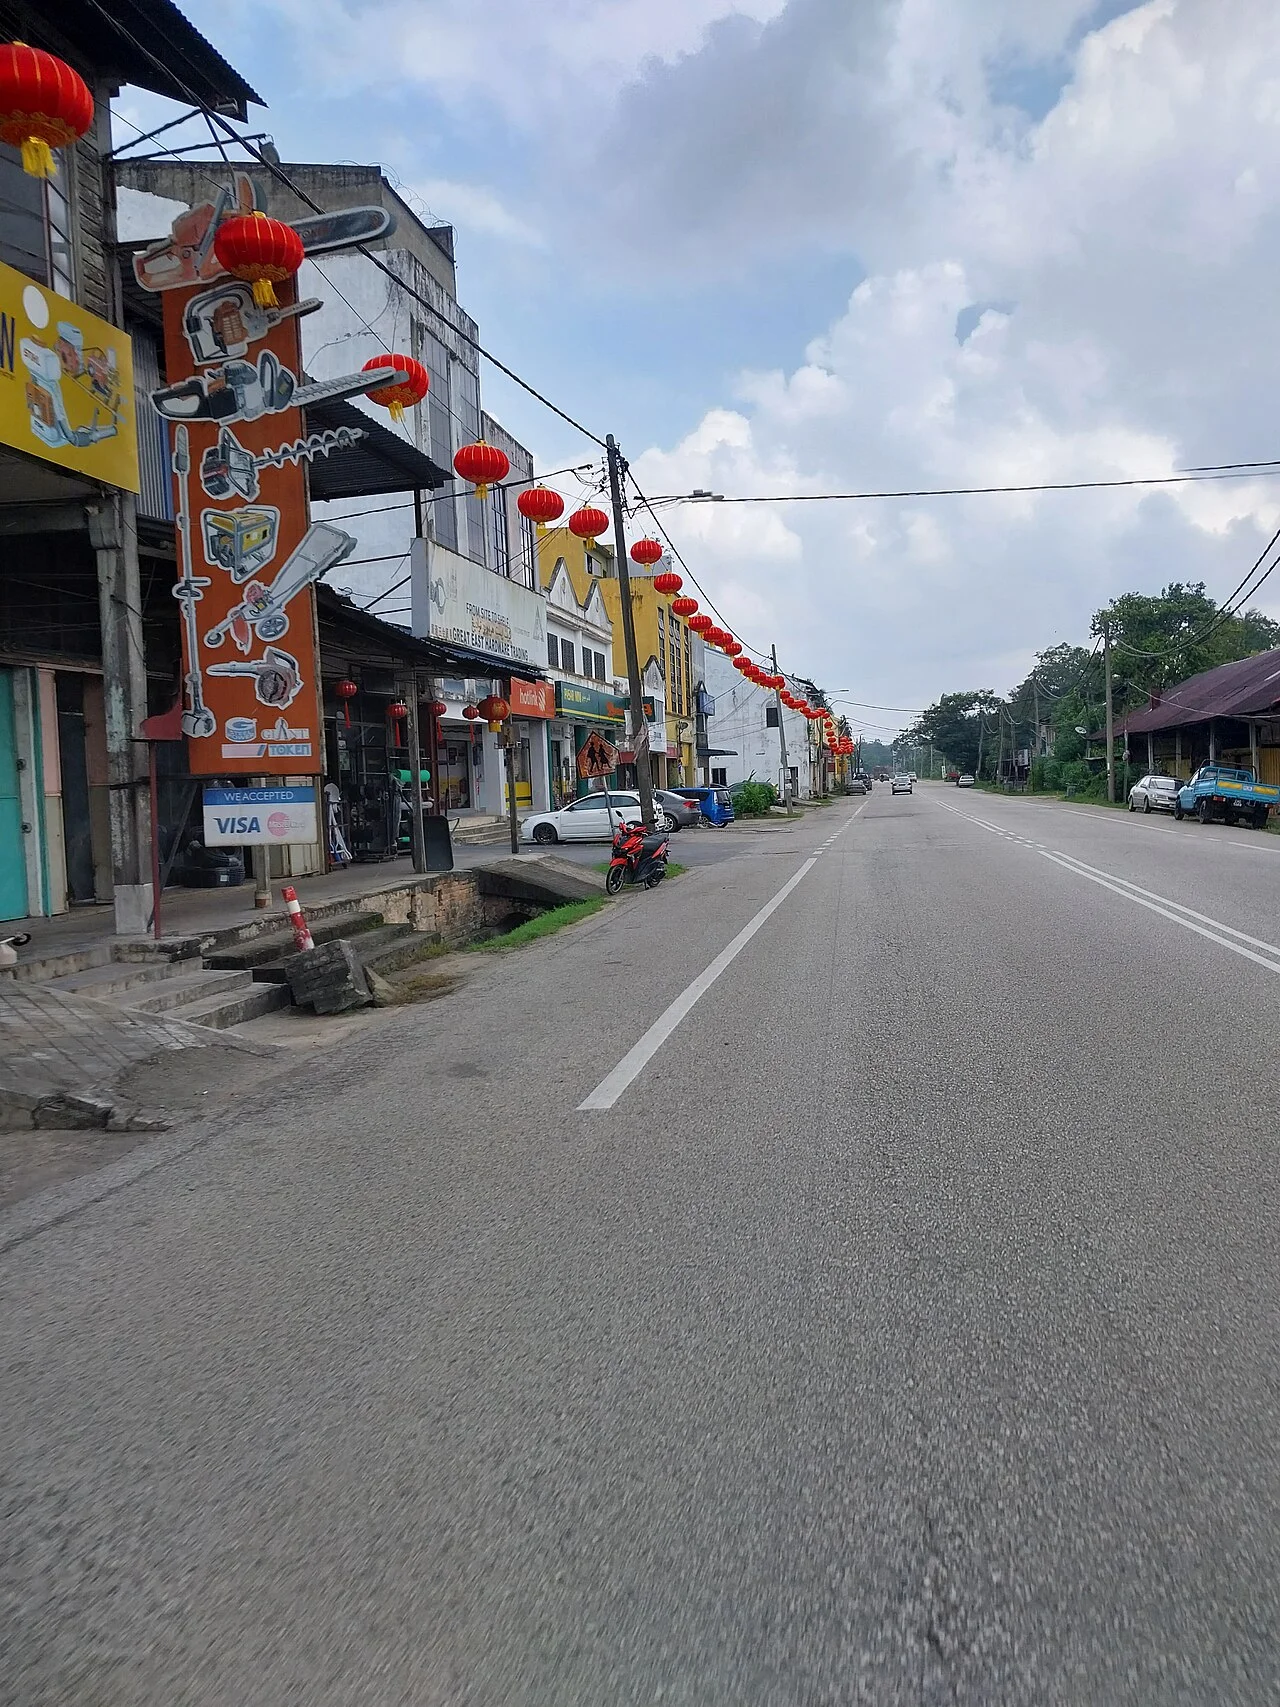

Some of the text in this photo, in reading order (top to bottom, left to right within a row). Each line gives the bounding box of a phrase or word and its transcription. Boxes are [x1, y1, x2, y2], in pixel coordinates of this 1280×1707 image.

[466, 602, 480, 617] FROM
[480, 607, 491, 621] SITE
[453, 627, 470, 645] GREAT
[471, 633, 484, 649] EAST
[485, 636, 510, 656] HARDWARE
[510, 645, 528, 661] TRADING
[519, 687, 539, 706] hotlink
[224, 791, 294, 801] WE ACCEPTED
[213, 816, 261, 834] VISA
